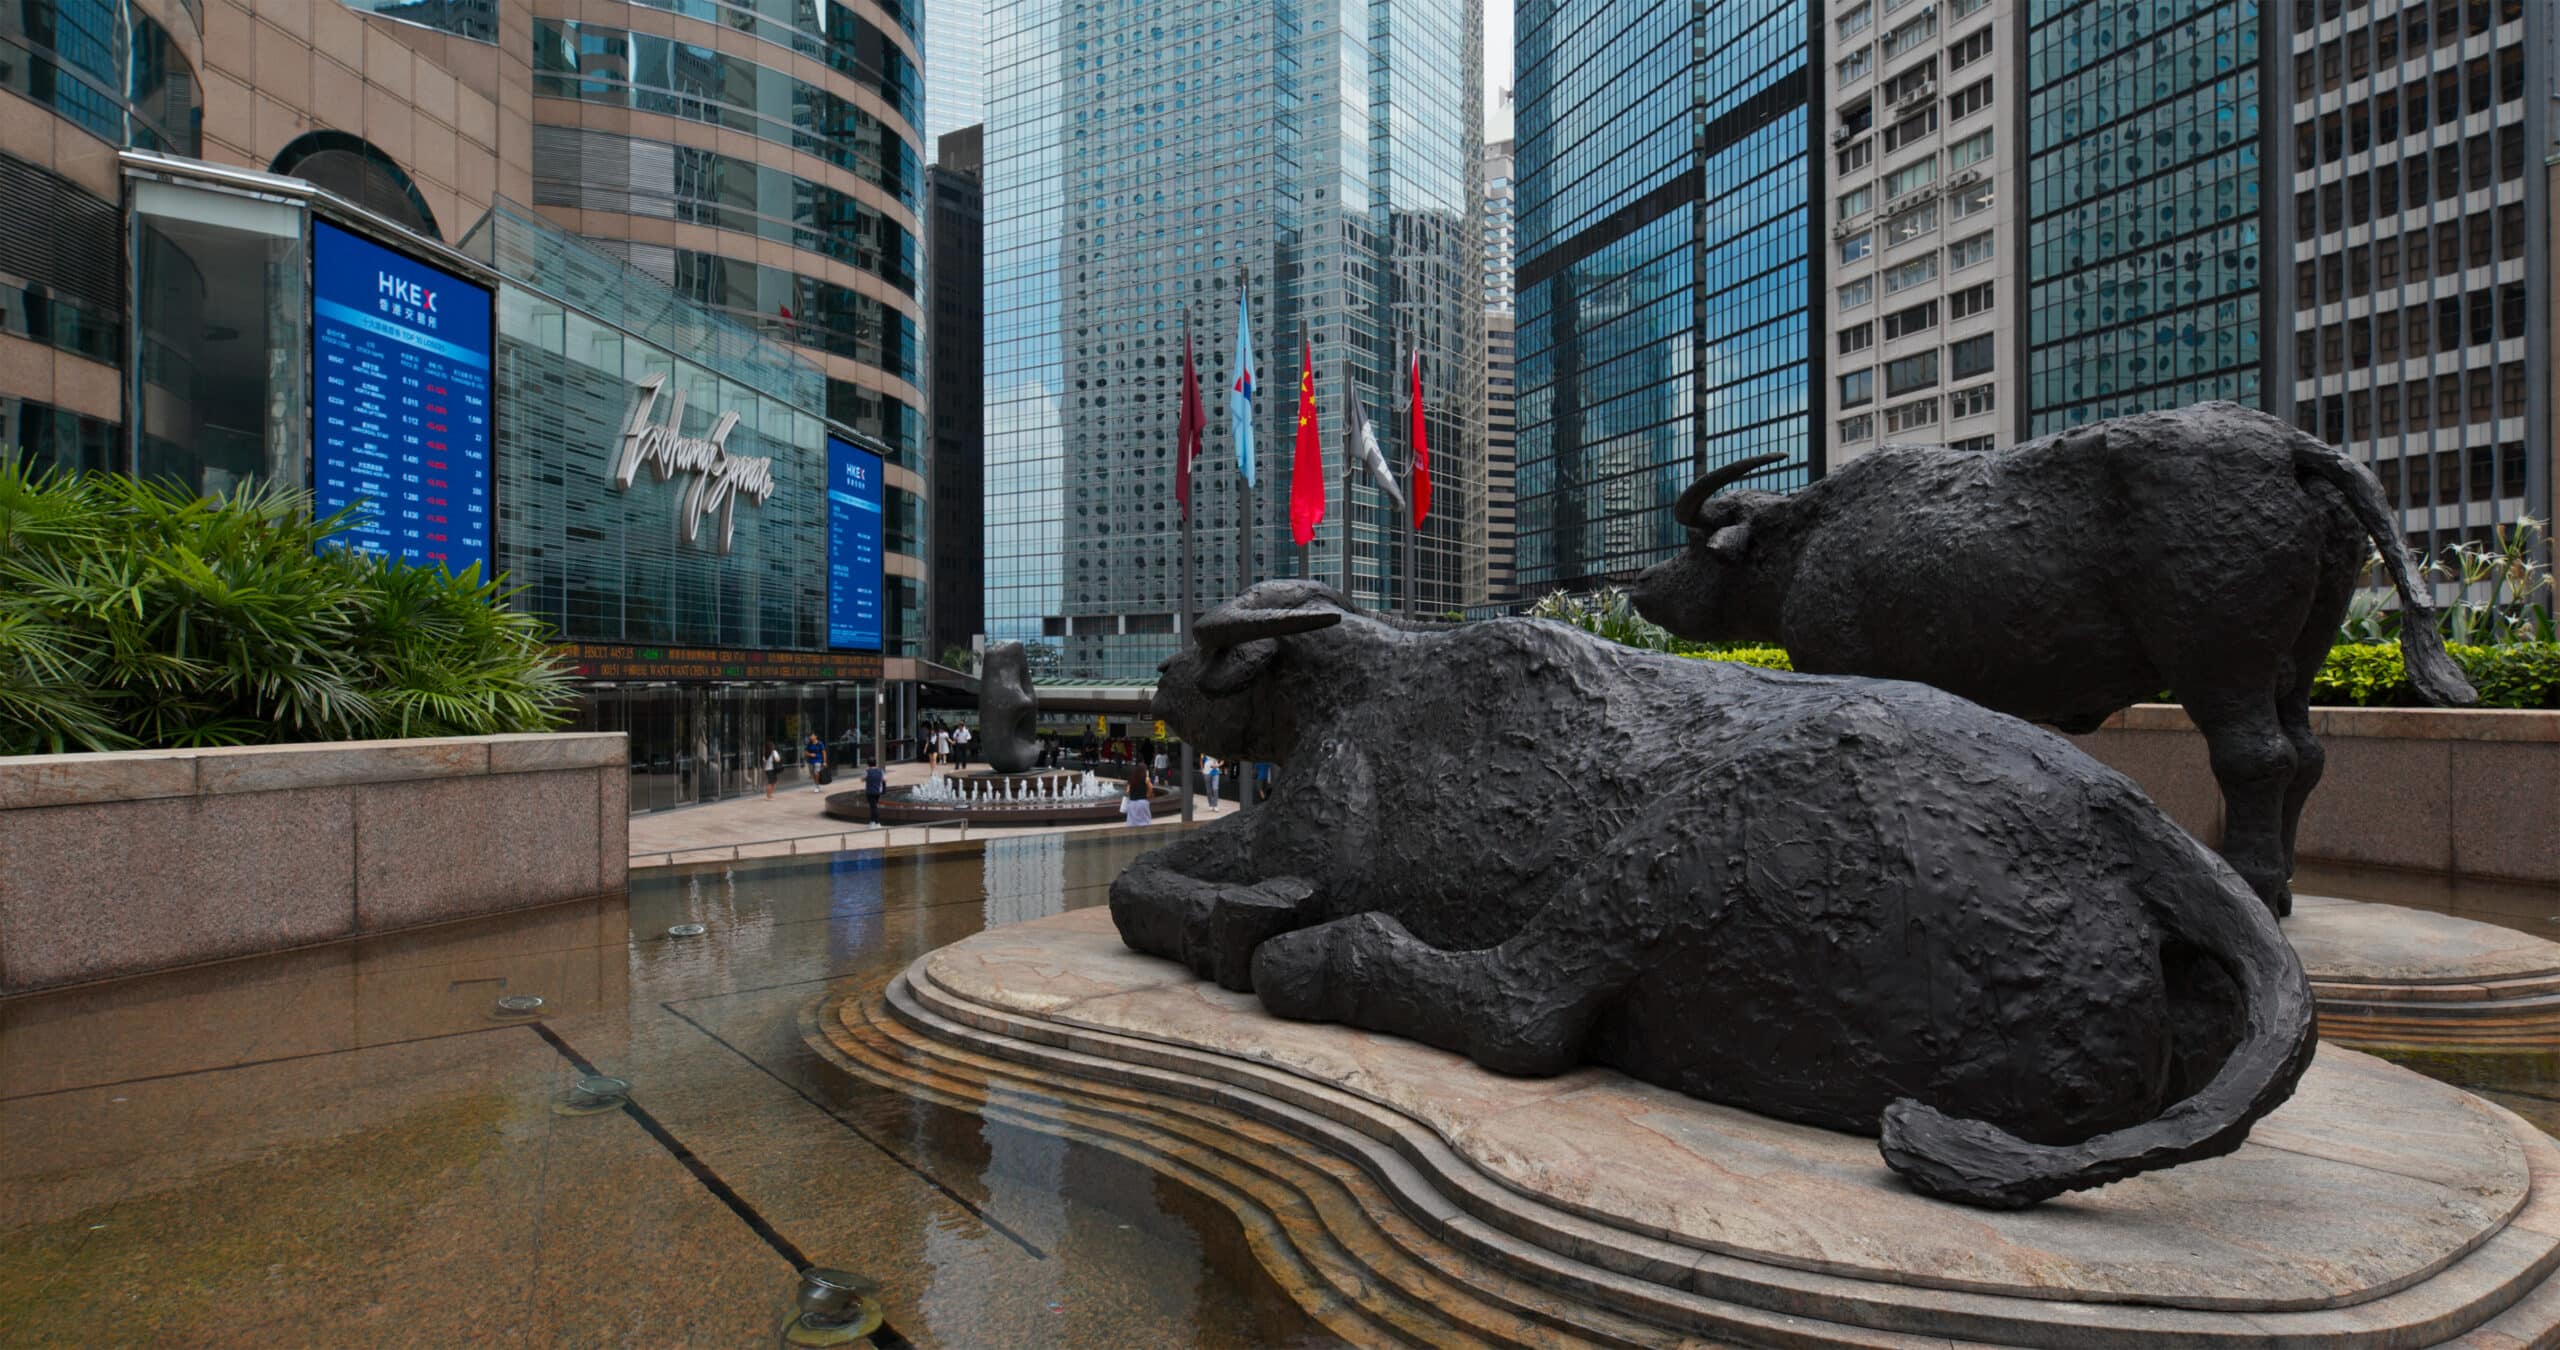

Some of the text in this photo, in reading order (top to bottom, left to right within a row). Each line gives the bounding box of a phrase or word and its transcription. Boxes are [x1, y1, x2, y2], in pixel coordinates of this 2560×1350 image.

[379, 271, 437, 312] HKEX
[379, 298, 437, 329] 香港交易所
[846, 464, 865, 481] HKEX
